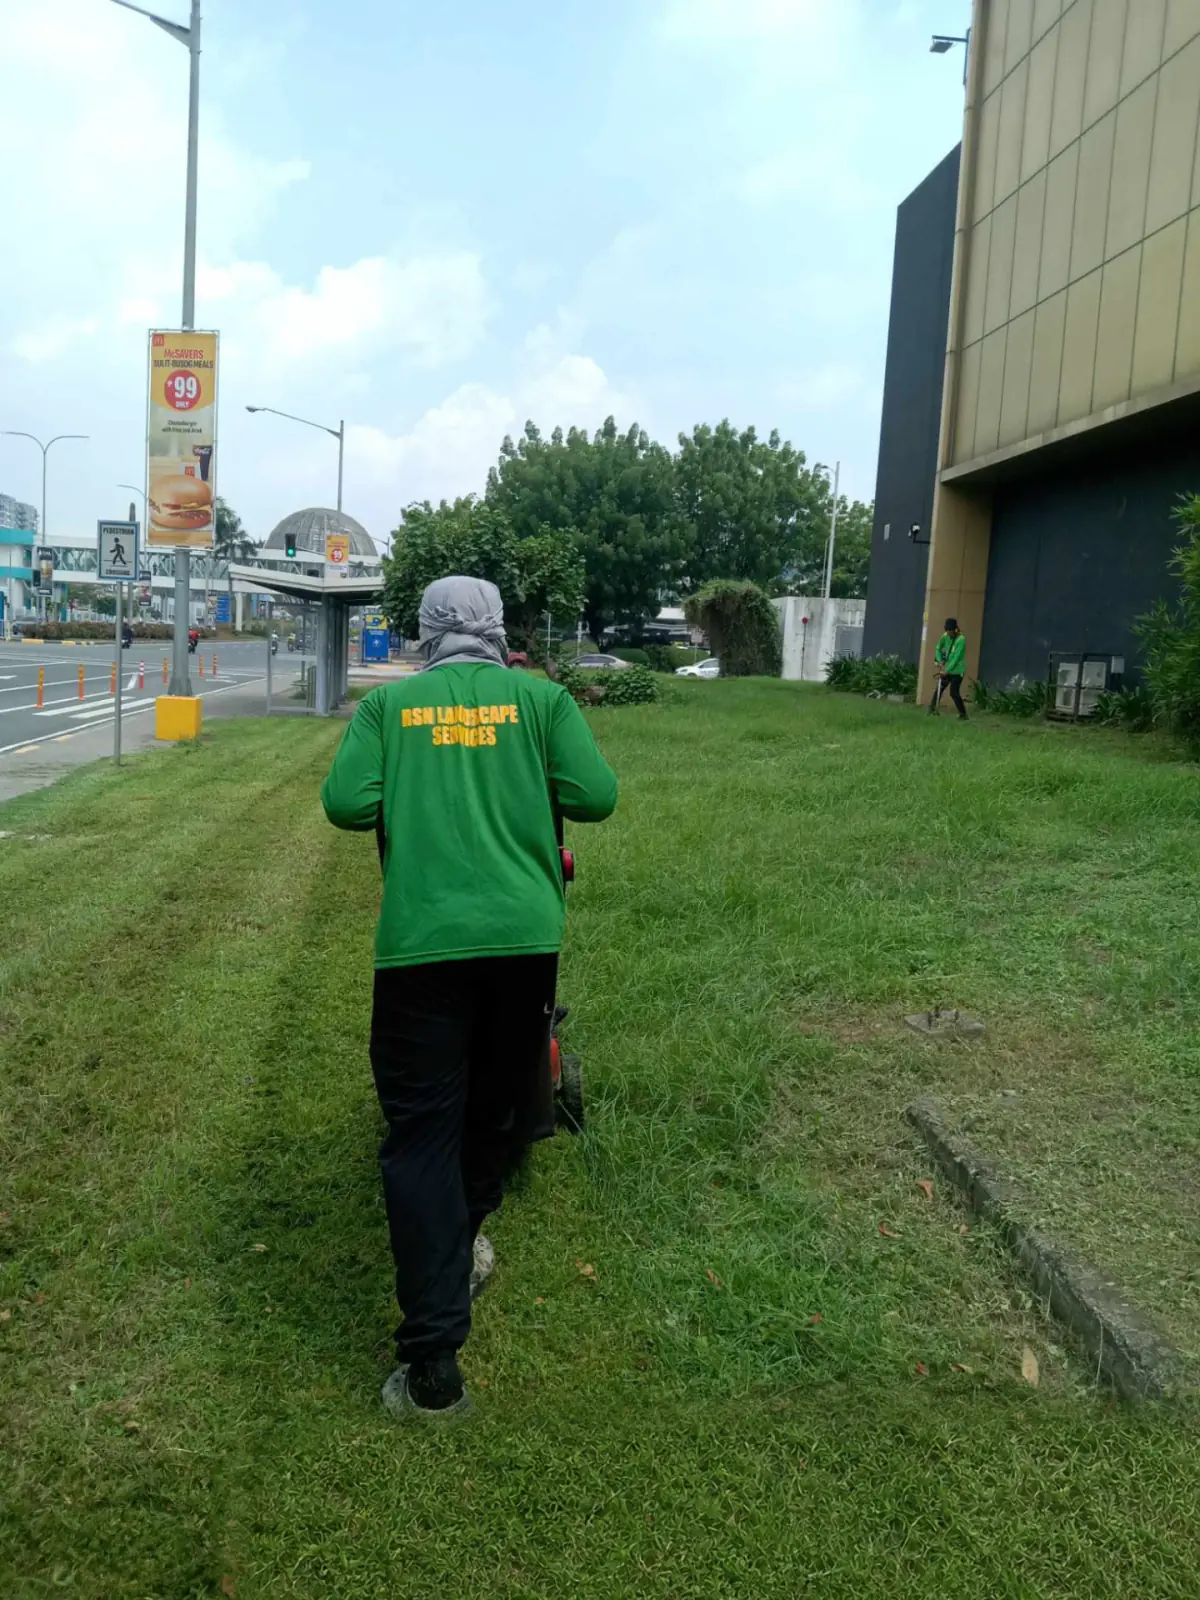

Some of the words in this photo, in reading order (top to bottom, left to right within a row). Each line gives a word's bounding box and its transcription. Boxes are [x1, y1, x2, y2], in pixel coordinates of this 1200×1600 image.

[163, 348, 204, 359] McSAVERS
[193, 360, 213, 368] MEALS
[103, 527, 134, 535] PEDESTRIAN
[401, 707, 435, 728] RSN
[431, 725, 497, 747] SERVICES
